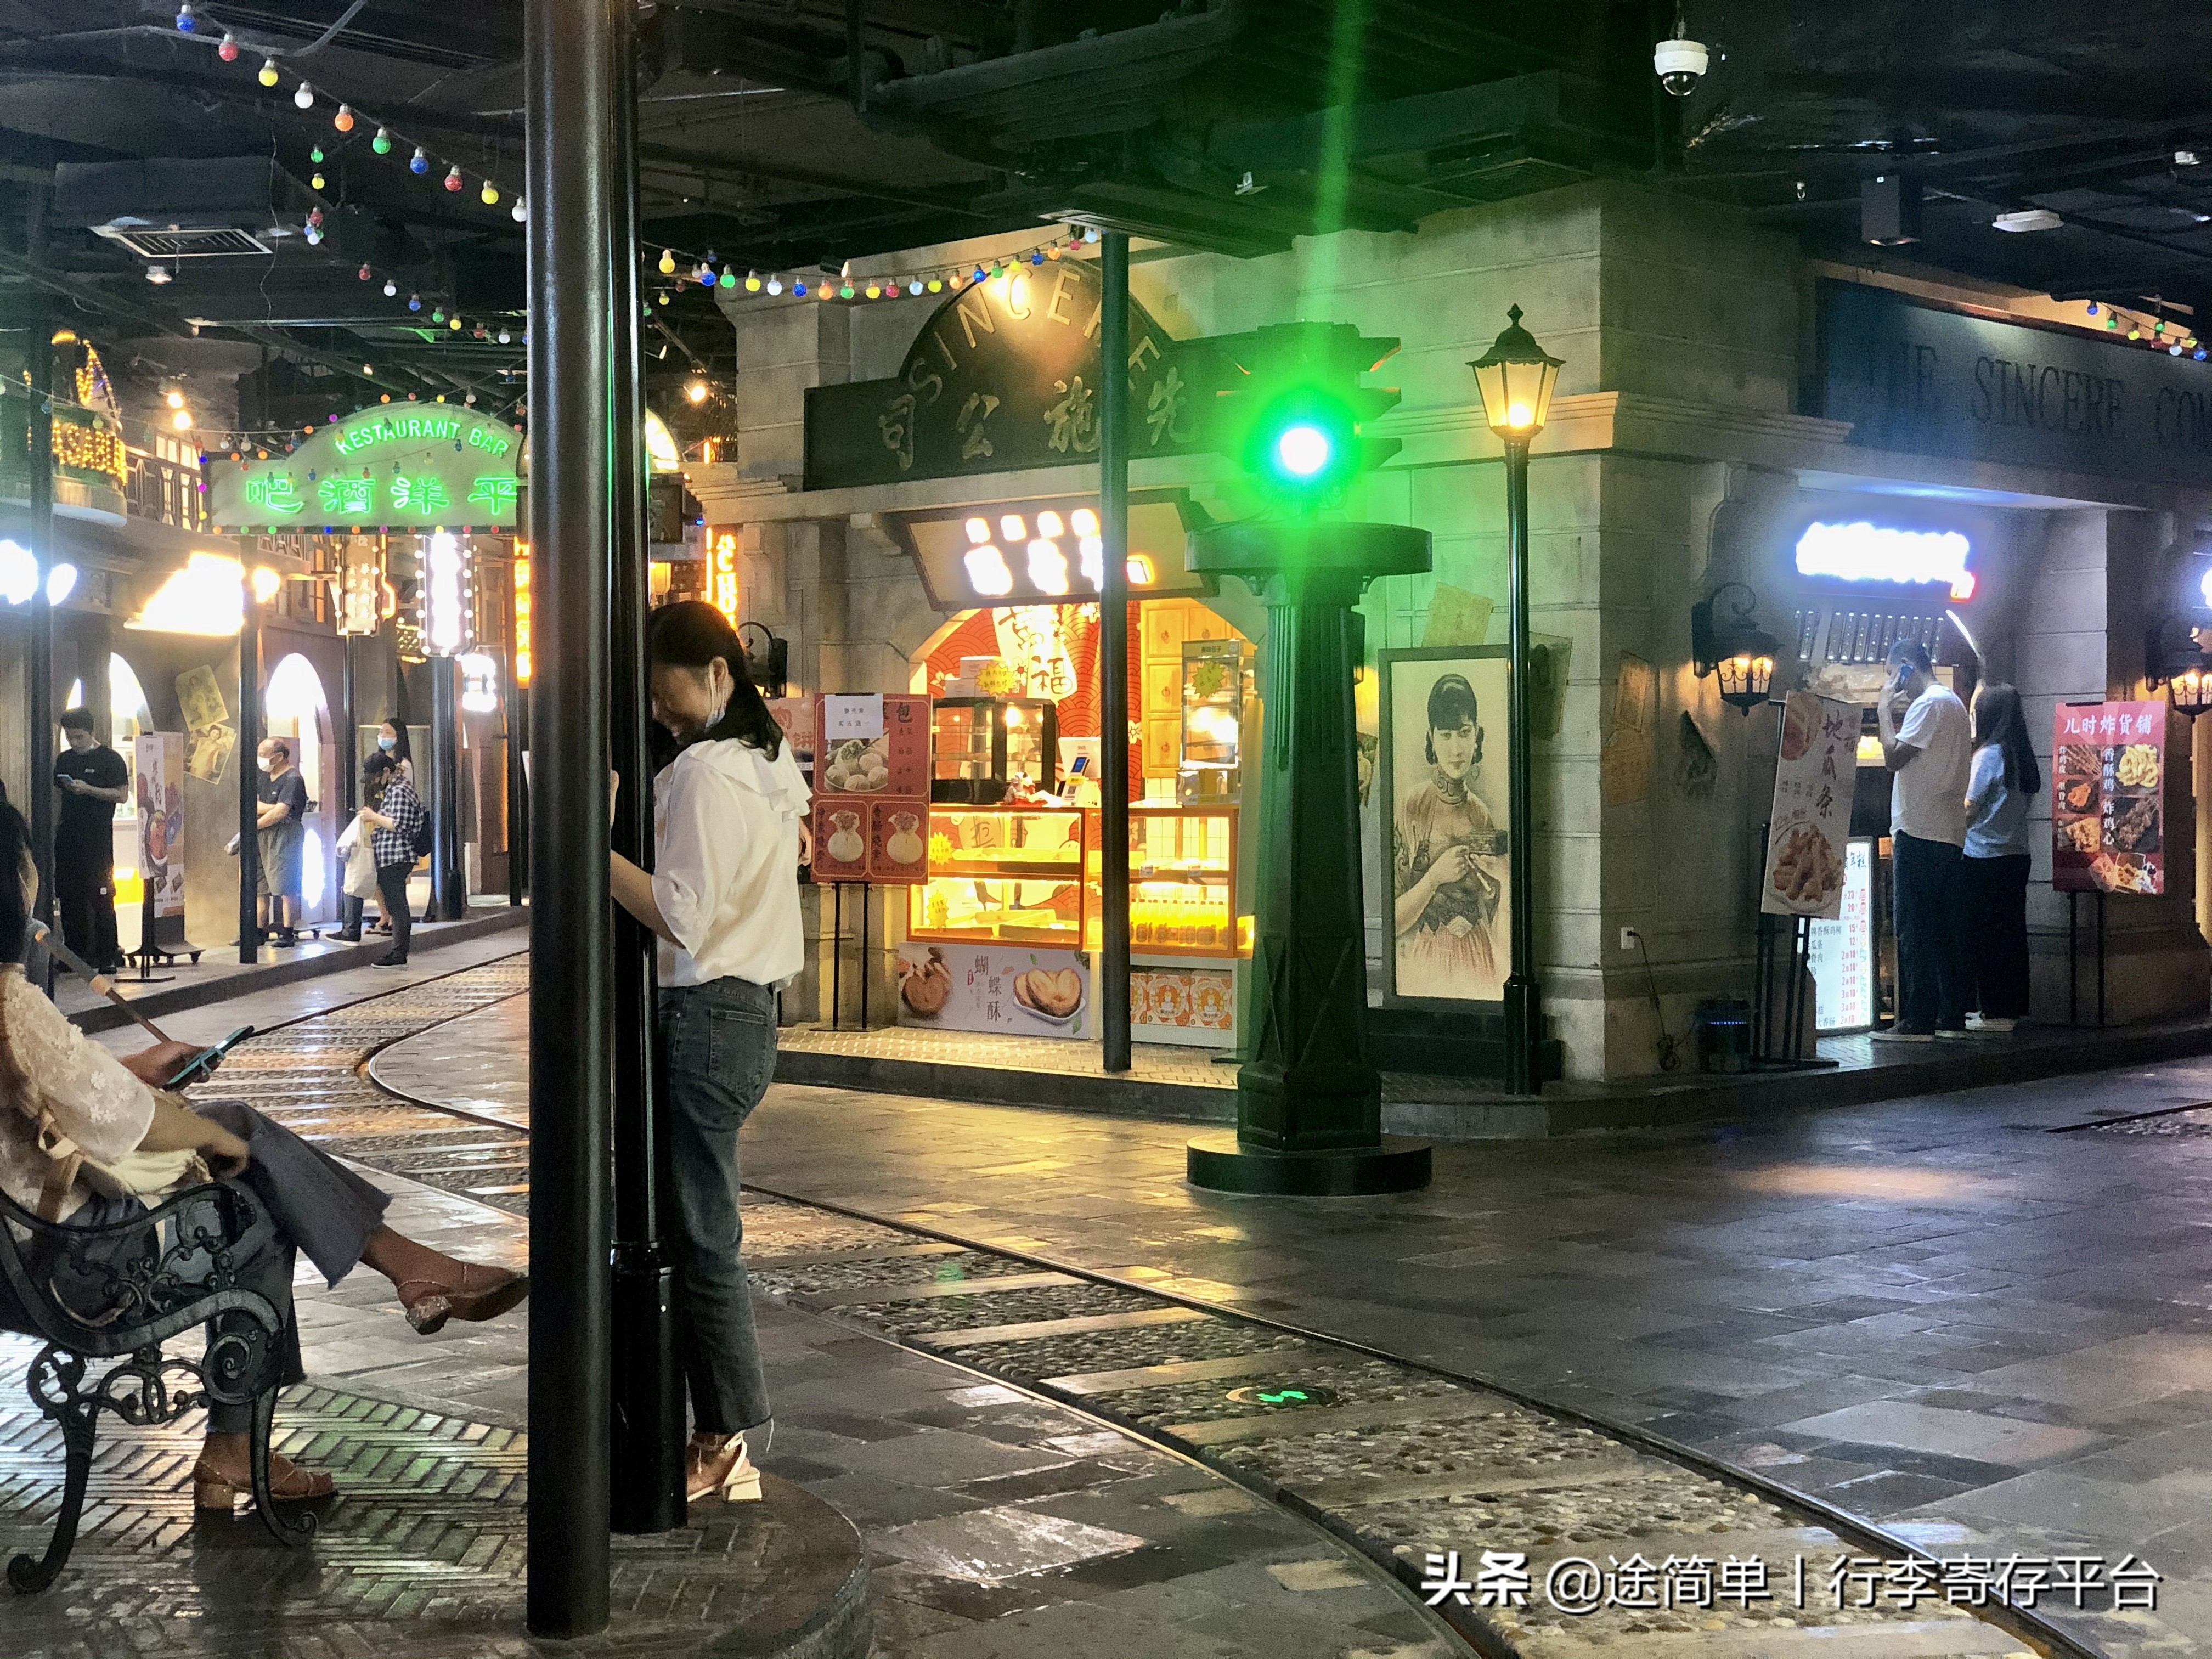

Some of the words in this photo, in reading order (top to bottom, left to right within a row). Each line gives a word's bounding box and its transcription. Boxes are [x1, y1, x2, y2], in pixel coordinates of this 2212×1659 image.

[908, 267, 1161, 403] SINCEE
[1971, 356, 2125, 441] SINCERE
[469, 428, 509, 458] BAR
[2064, 714, 2153, 735] 儿时炸货铺
[2103, 748, 2115, 792] 香酥鸡
[2102, 801, 2115, 845] 炸鸡心
[1808, 940, 1823, 950] 瓜条
[1808, 952, 1824, 963] 脊肉
[974, 955, 1002, 1022] 蝴蝶酥
